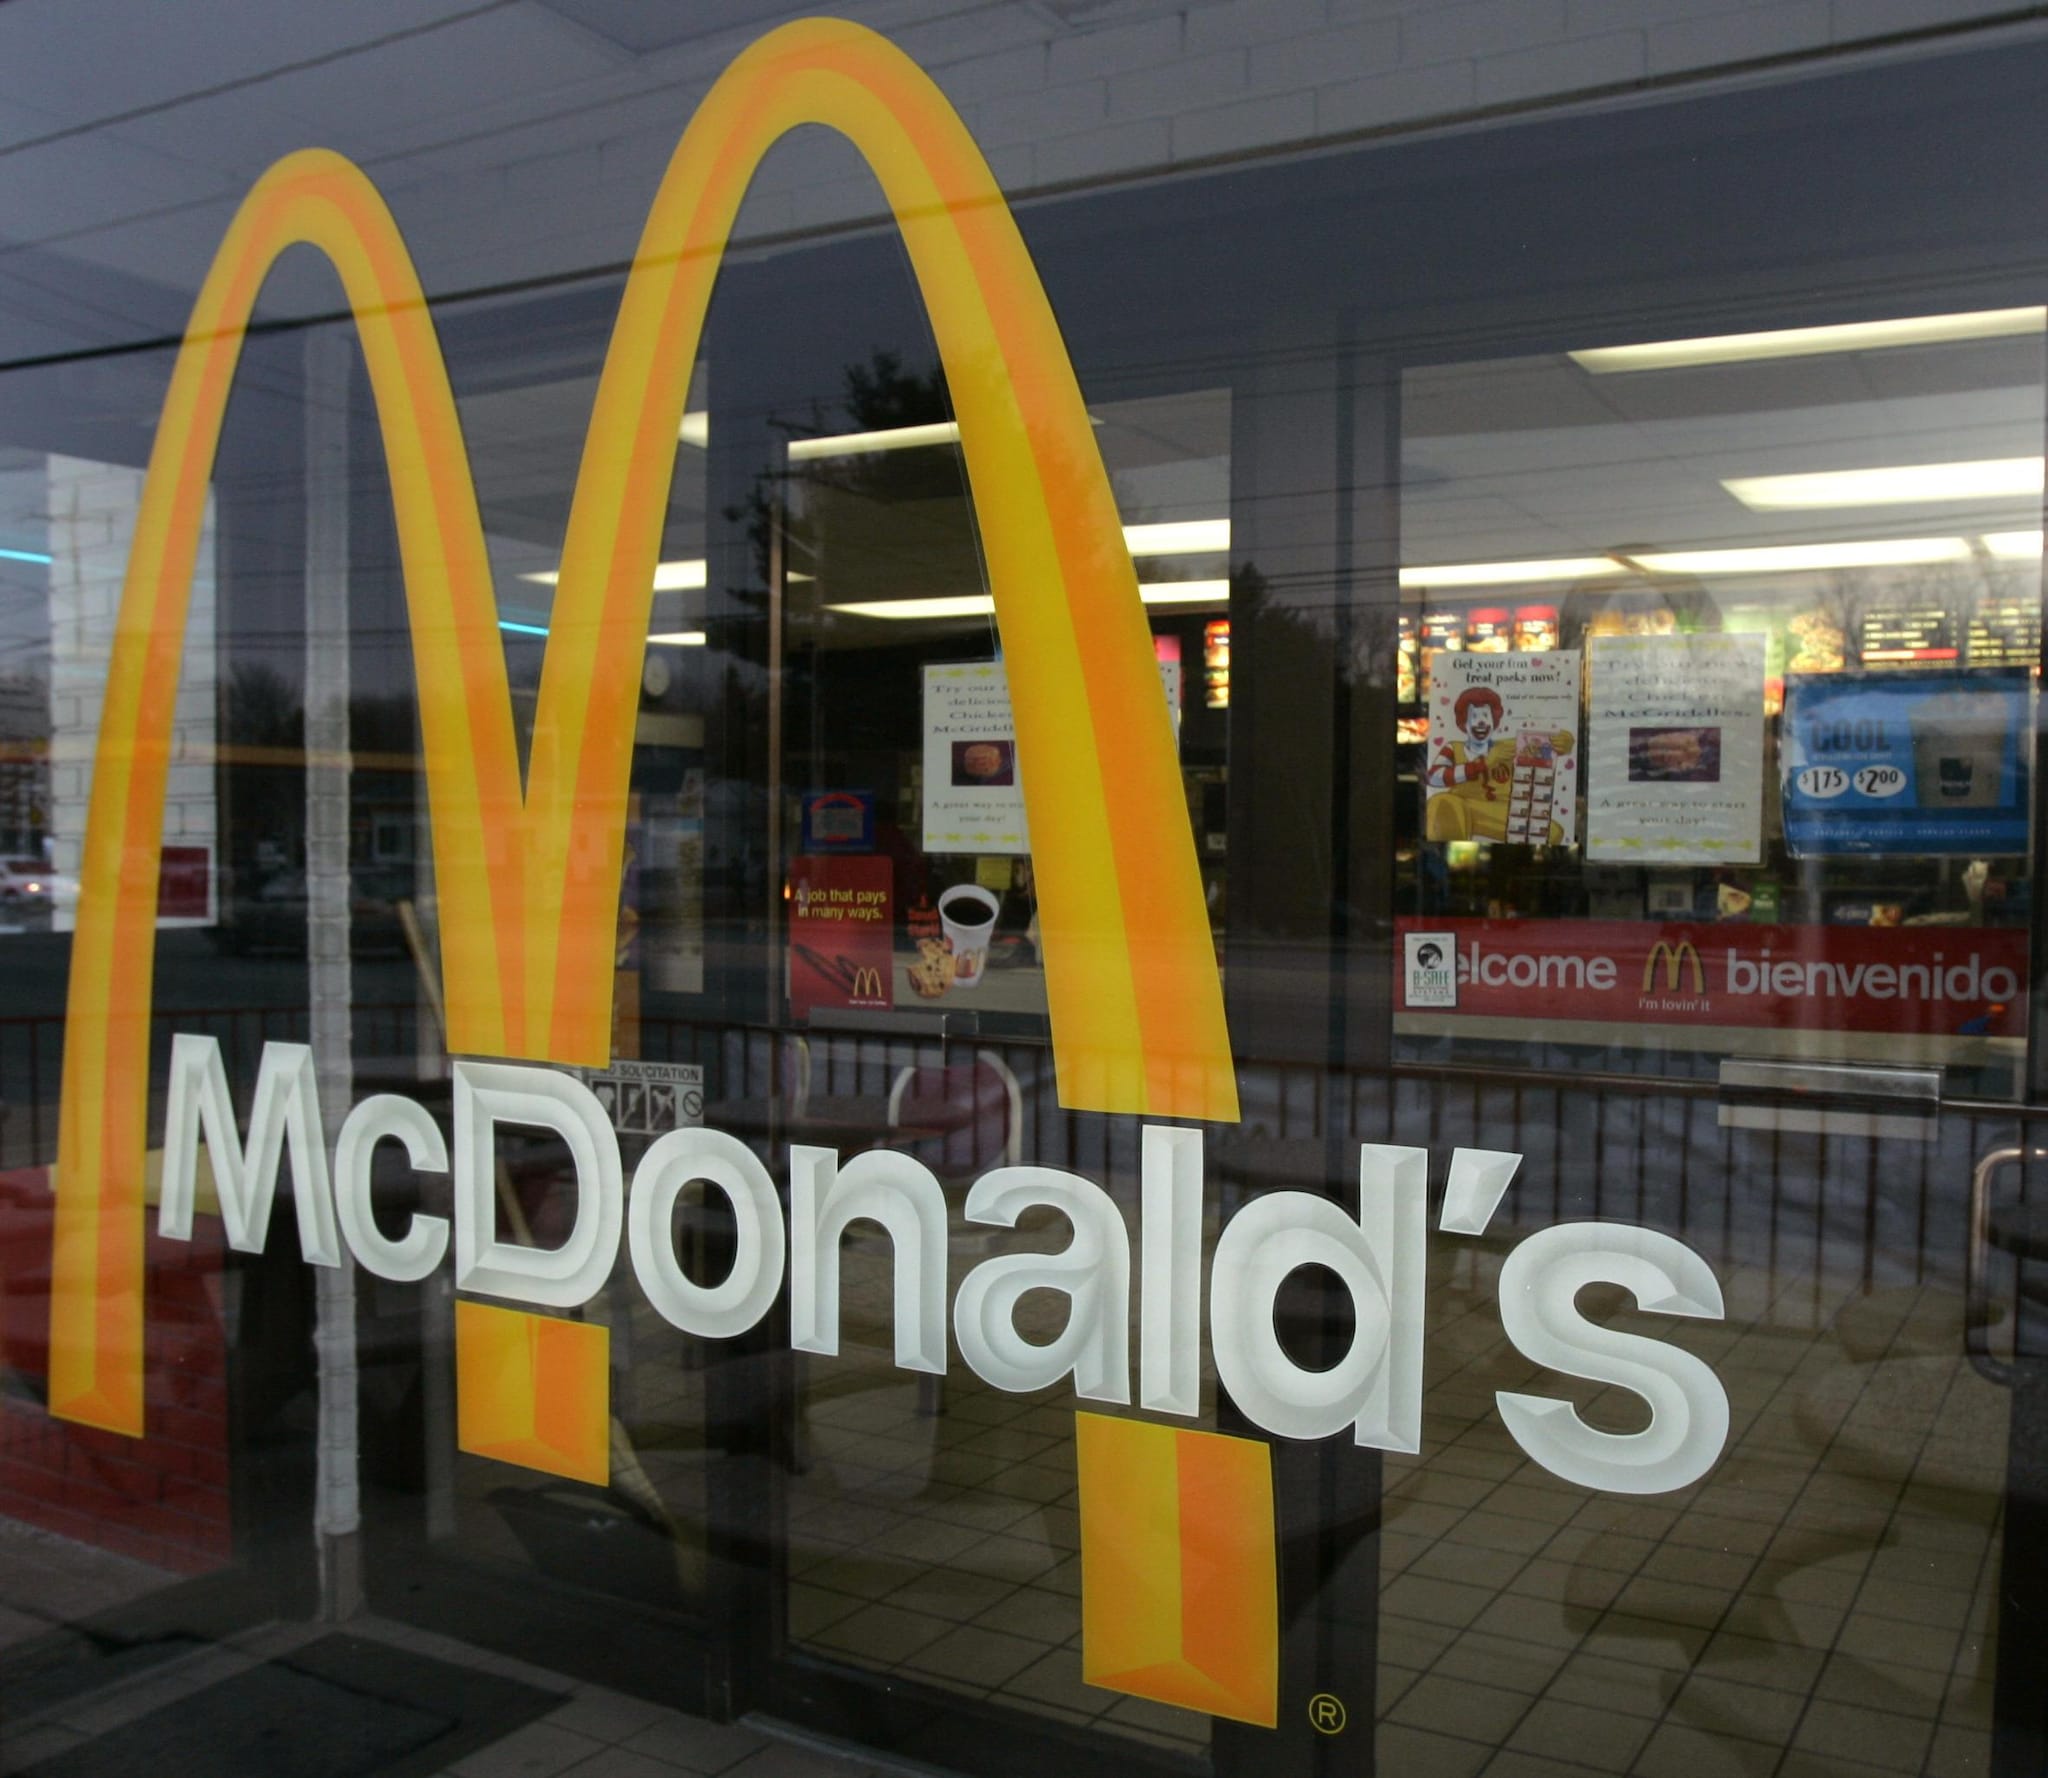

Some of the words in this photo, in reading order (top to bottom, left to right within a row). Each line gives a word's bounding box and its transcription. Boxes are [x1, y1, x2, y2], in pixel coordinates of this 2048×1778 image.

[1453, 658, 1473, 670] Get
[1476, 661, 1505, 672] your
[1508, 657, 1529, 670] fun
[1466, 671, 1493, 683] treat
[1496, 671, 1527, 686] packs
[1531, 671, 1561, 684] now!
[795, 888, 805, 902] A
[806, 888, 827, 905] job
[830, 888, 854, 902] that
[857, 890, 888, 906] pays
[812, 907, 845, 921] many
[848, 908, 883, 922] ways.
[1726, 947, 2018, 1003] bienvenido
[1662, 997, 1699, 1012] lovin'
[1701, 1000, 1711, 1012] it
[157, 1032, 1731, 1495] McDonald's
